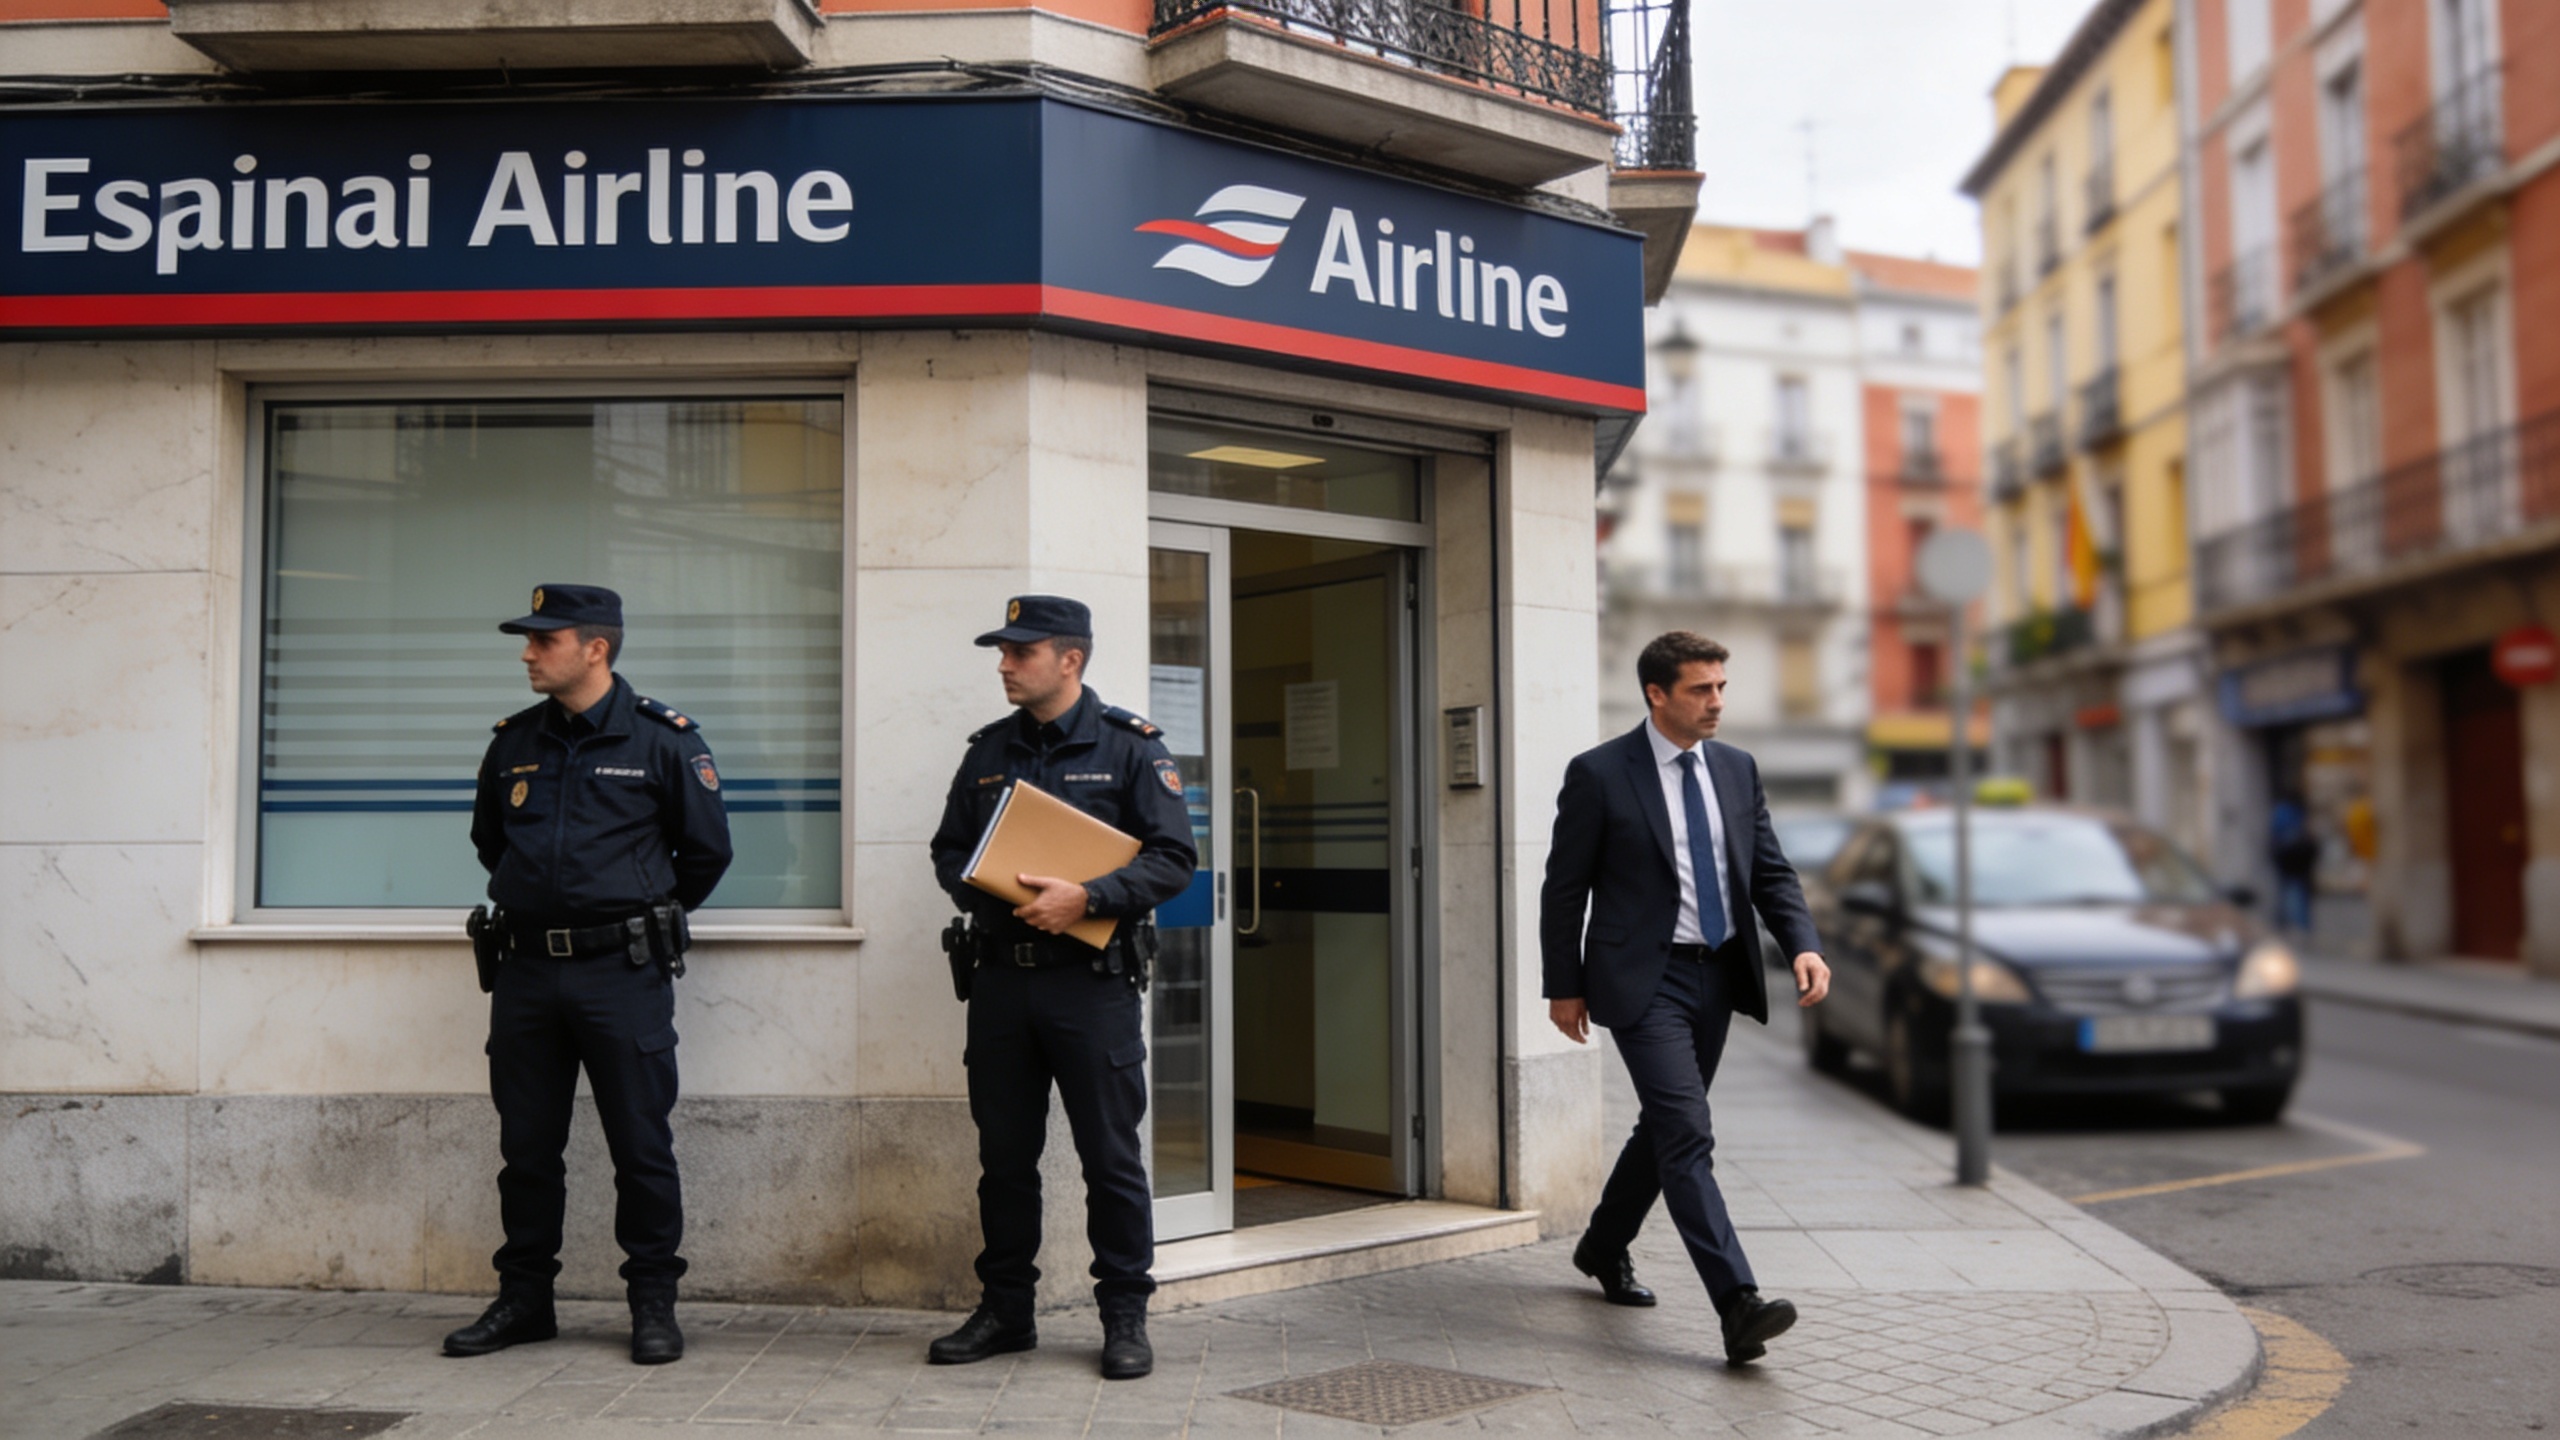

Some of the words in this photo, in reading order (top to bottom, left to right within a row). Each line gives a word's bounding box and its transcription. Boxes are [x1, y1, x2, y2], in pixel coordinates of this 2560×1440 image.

[21, 153, 431, 275] Espainai
[467, 148, 854, 246] Airline
[1309, 206, 1569, 338] Airline
